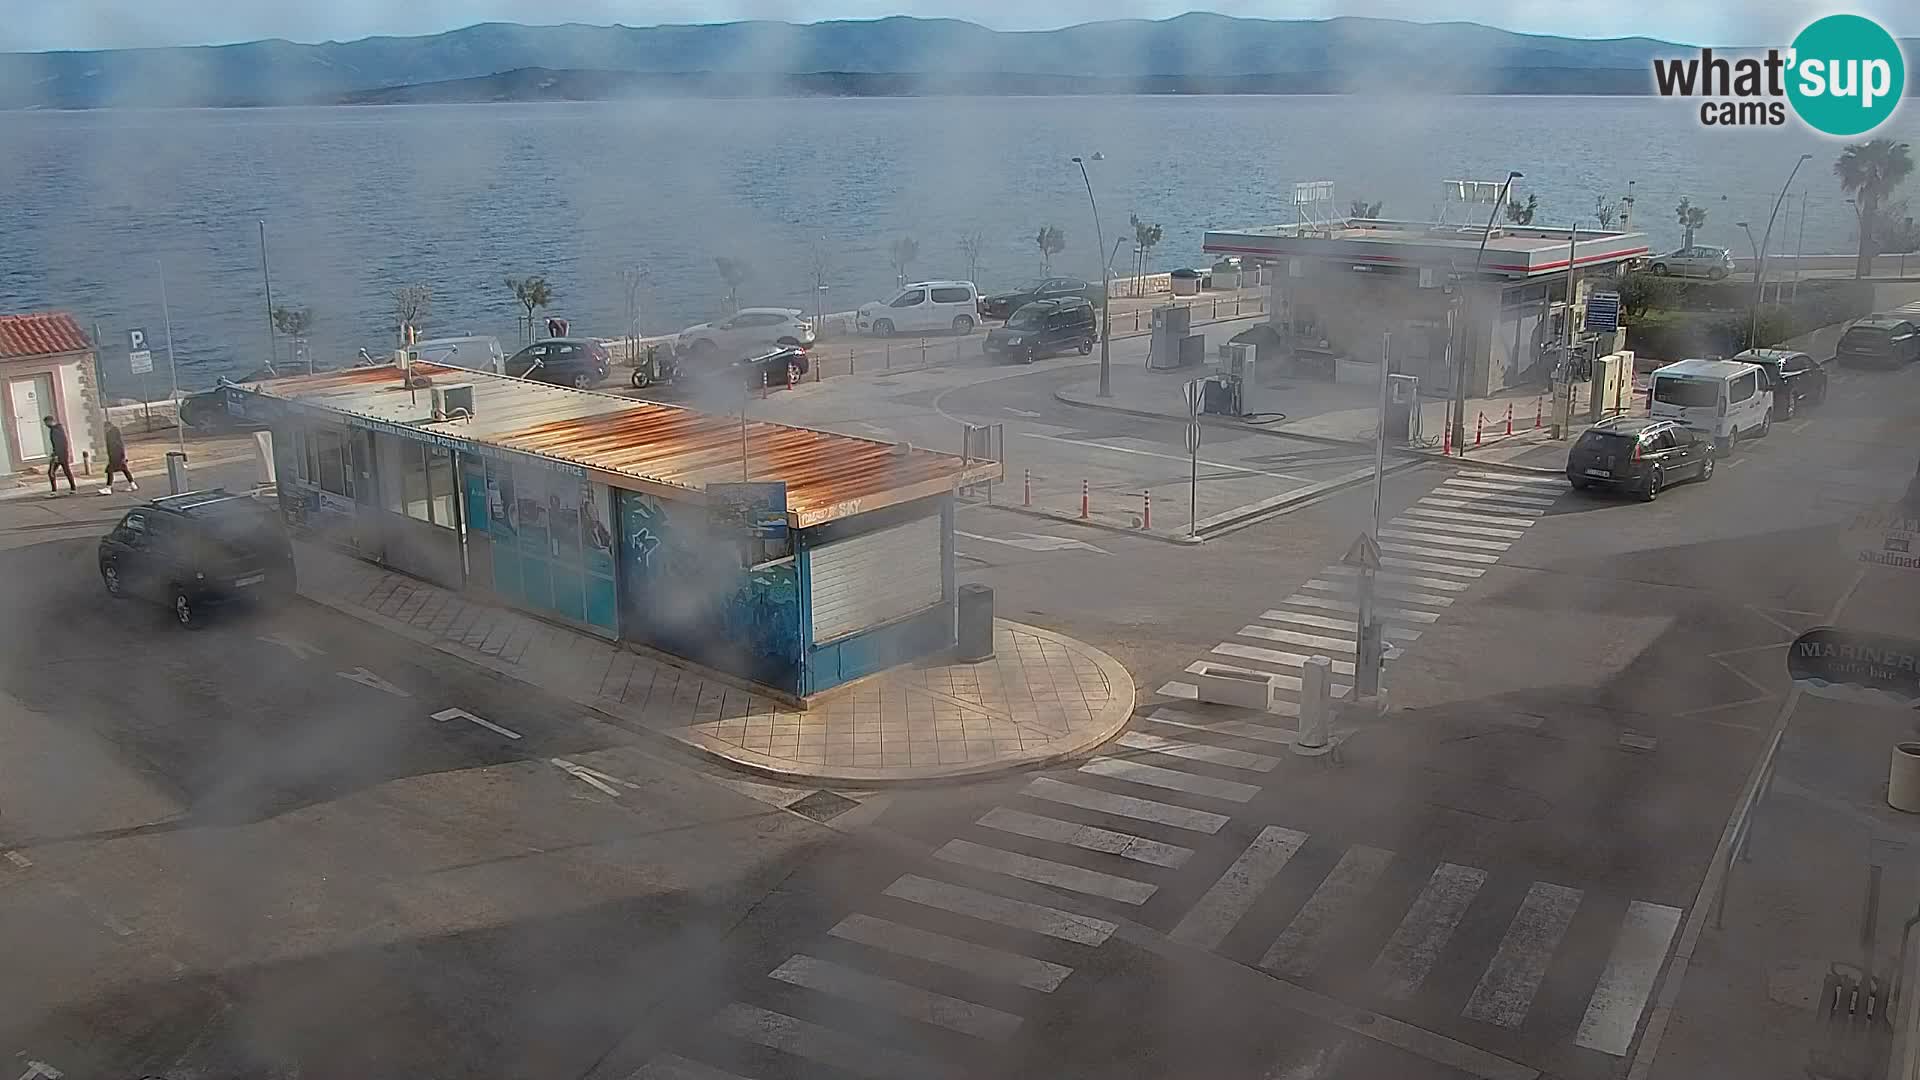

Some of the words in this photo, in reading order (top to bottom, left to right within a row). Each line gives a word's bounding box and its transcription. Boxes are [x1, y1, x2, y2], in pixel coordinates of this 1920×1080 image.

[131, 330, 144, 349] P
[437, 439, 468, 450] POSTAJA
[556, 464, 584, 477] OFFICE
